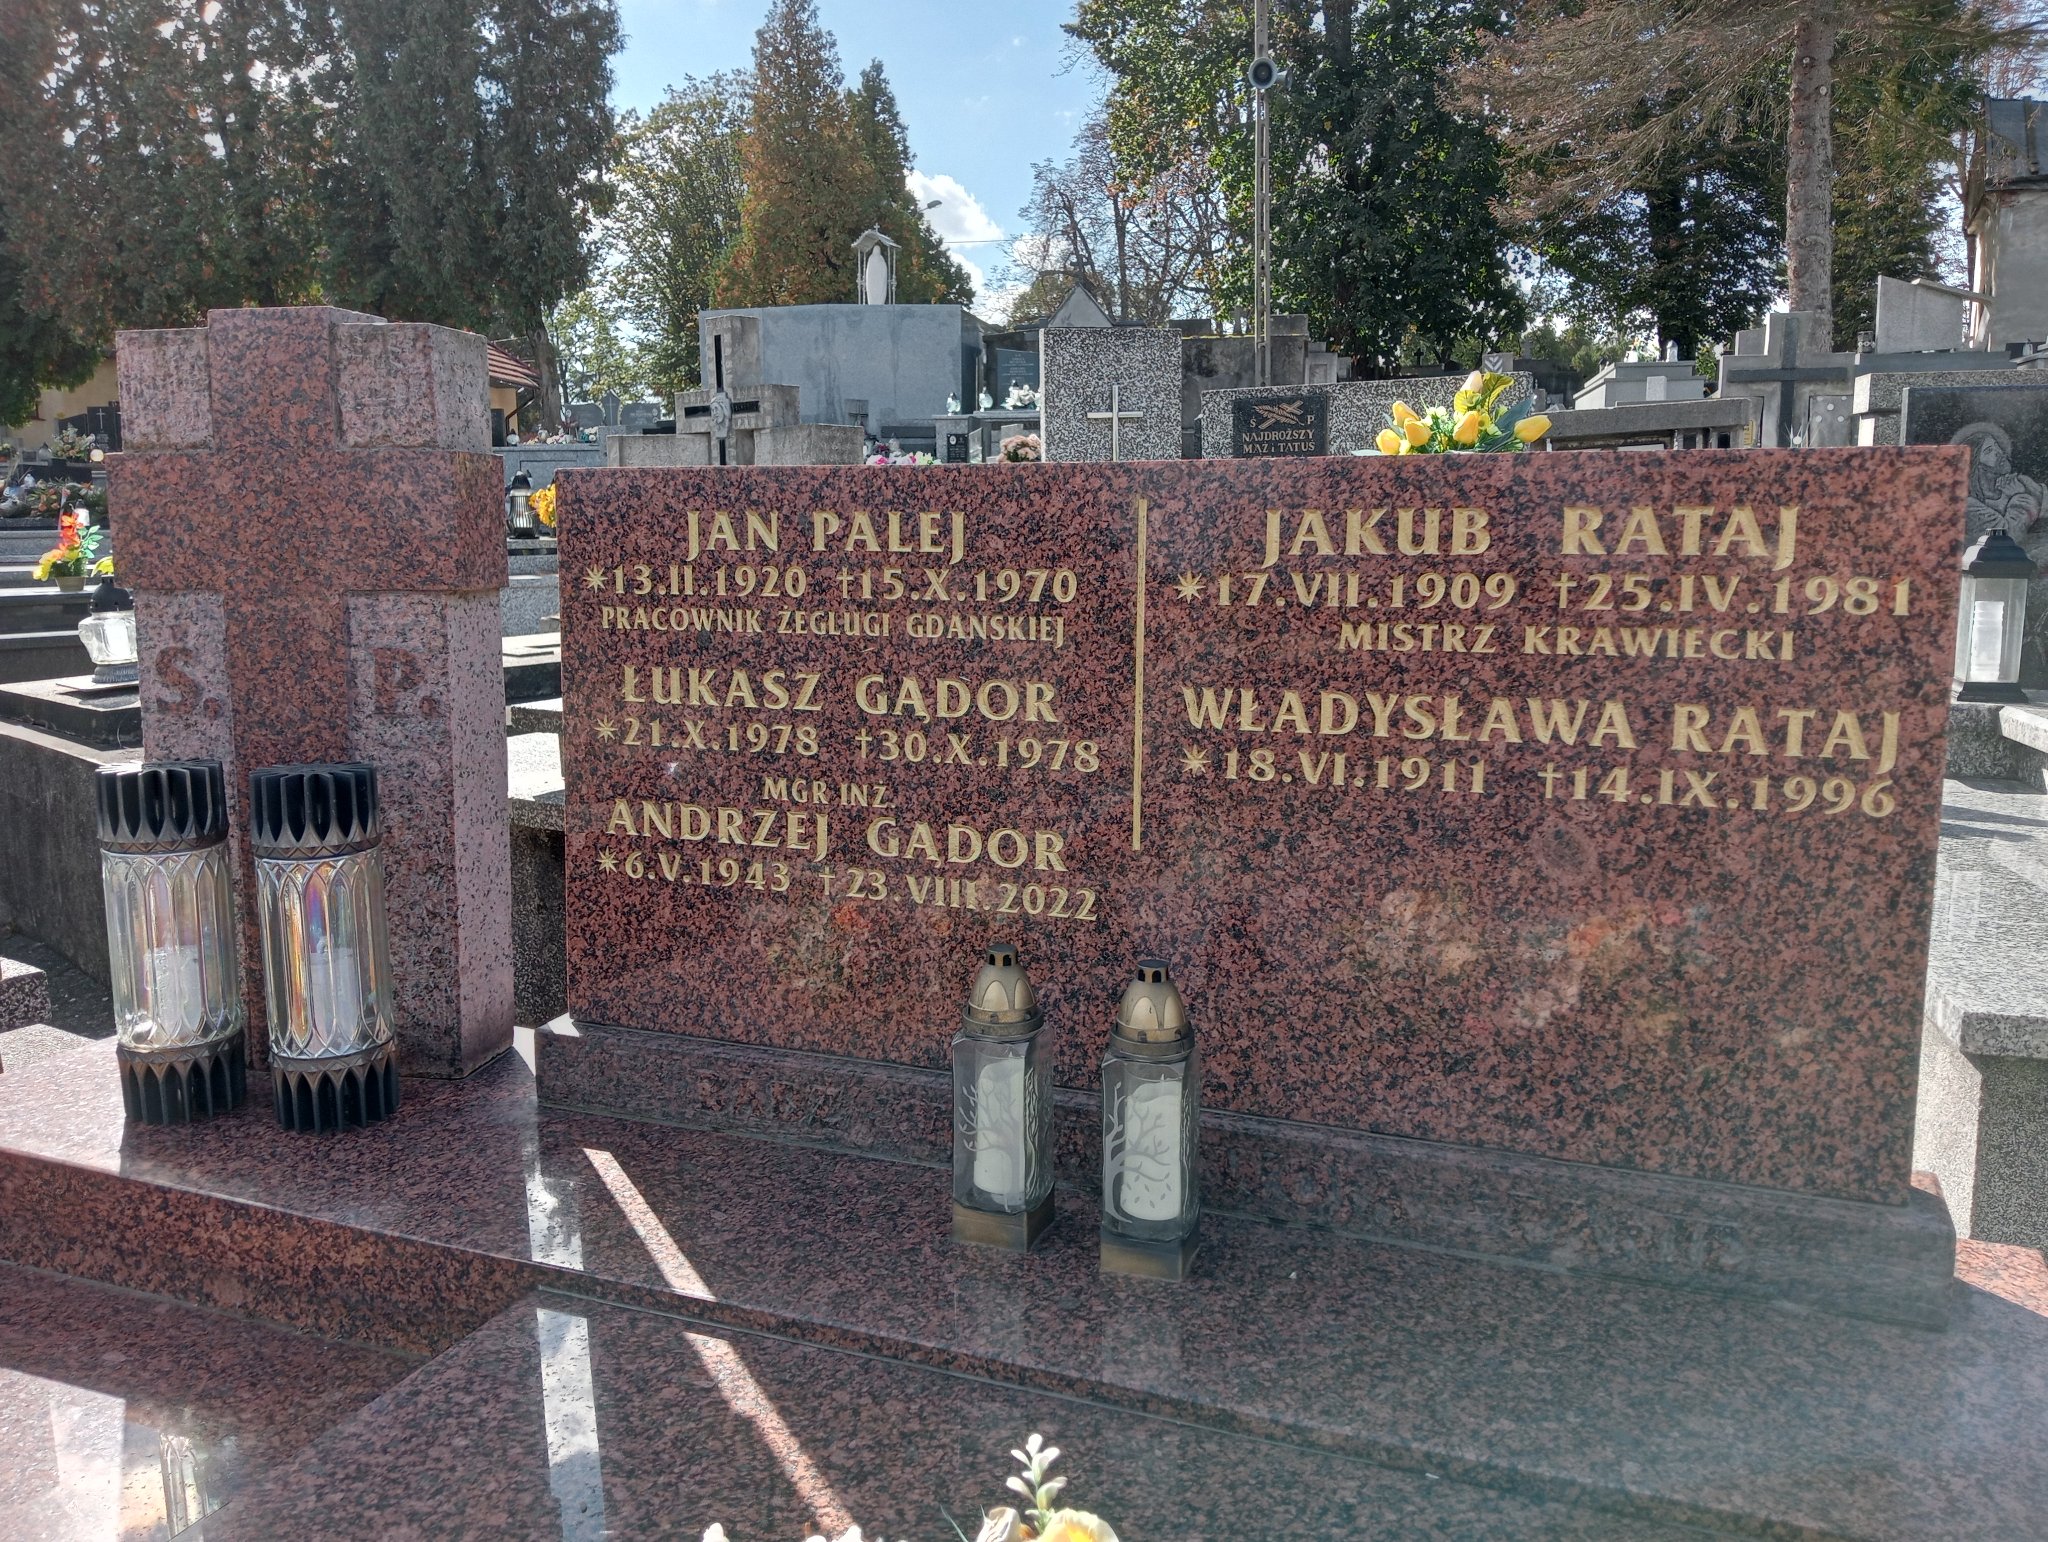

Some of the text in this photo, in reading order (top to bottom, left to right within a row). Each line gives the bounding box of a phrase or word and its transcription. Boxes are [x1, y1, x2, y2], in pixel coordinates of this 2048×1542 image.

[1242, 429, 1315, 442] NAJDROŻSZY
[1307, 415, 1315, 424] P
[686, 510, 966, 565] JAN PALEJ
[1262, 506, 1801, 572] JAKUB RATAJ
[601, 605, 763, 633] PRACOWNIK
[777, 606, 890, 638] ŻEGLUGI
[1338, 622, 1795, 661] MISTRZ KRAWIECKI
[620, 664, 1059, 724] ŁUKASZ GĄDOR
[1182, 686, 1901, 776] WŁADYSŁAWA RATAJ
[762, 776, 829, 805] MGR
[606, 799, 1069, 873] ANDRZEJ GĄDOR
